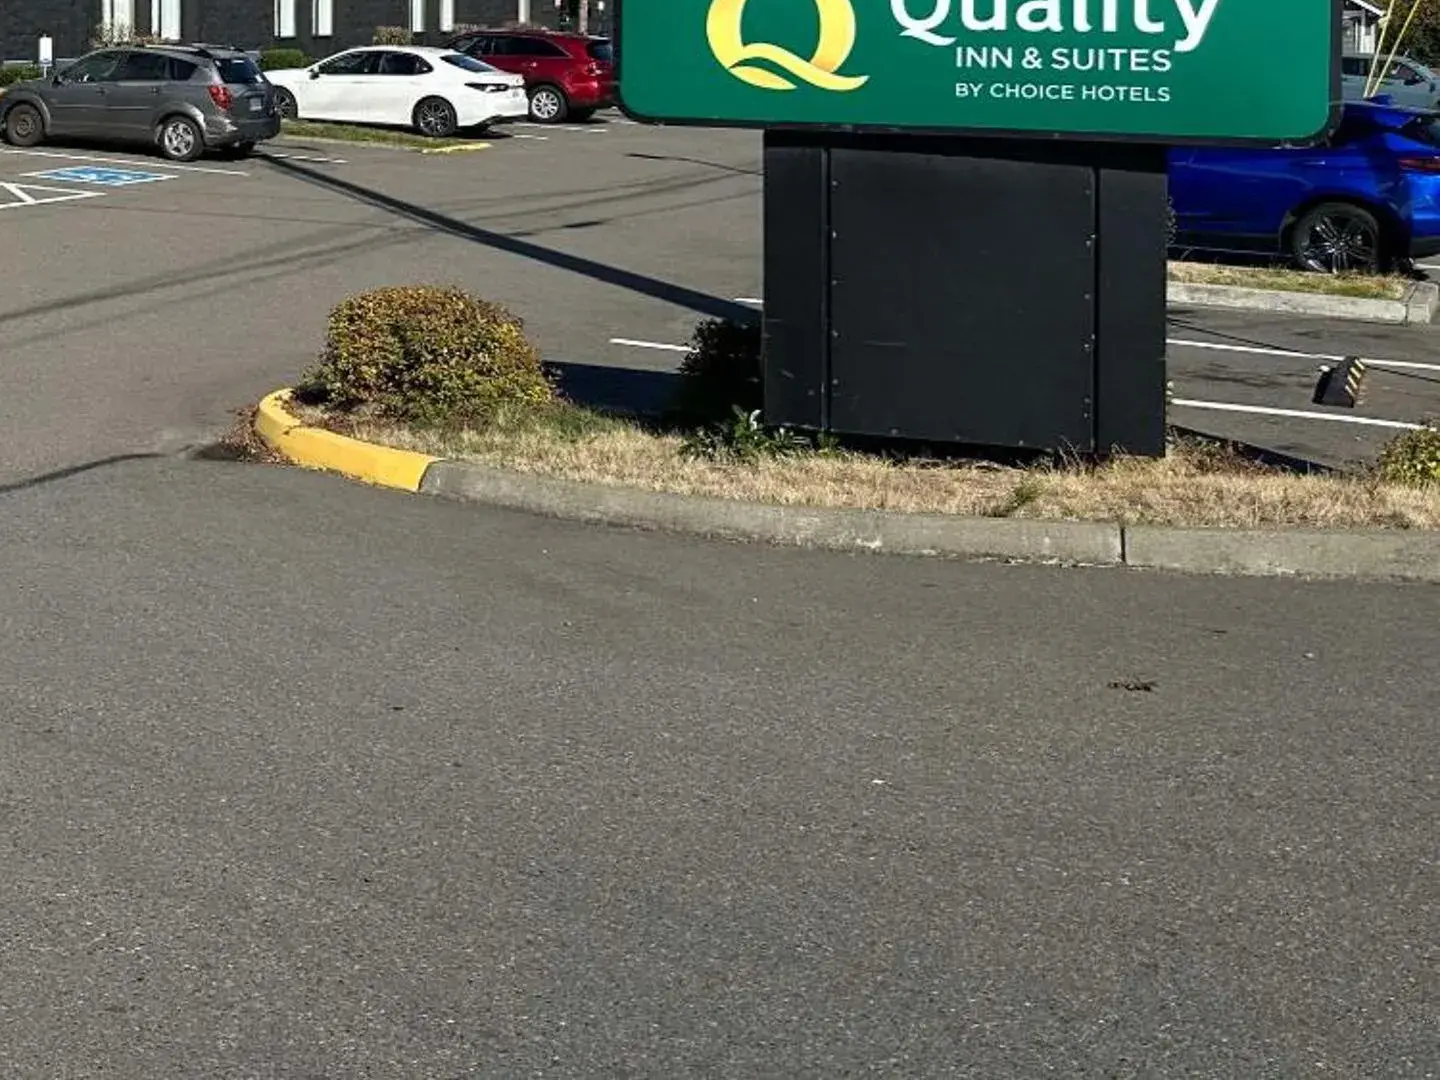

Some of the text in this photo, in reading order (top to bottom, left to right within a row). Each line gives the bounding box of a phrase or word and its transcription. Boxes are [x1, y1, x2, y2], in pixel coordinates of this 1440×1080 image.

[955, 46, 1173, 72] INN & SUITES
[955, 82, 1171, 102] BY CHOICE HOTELS
